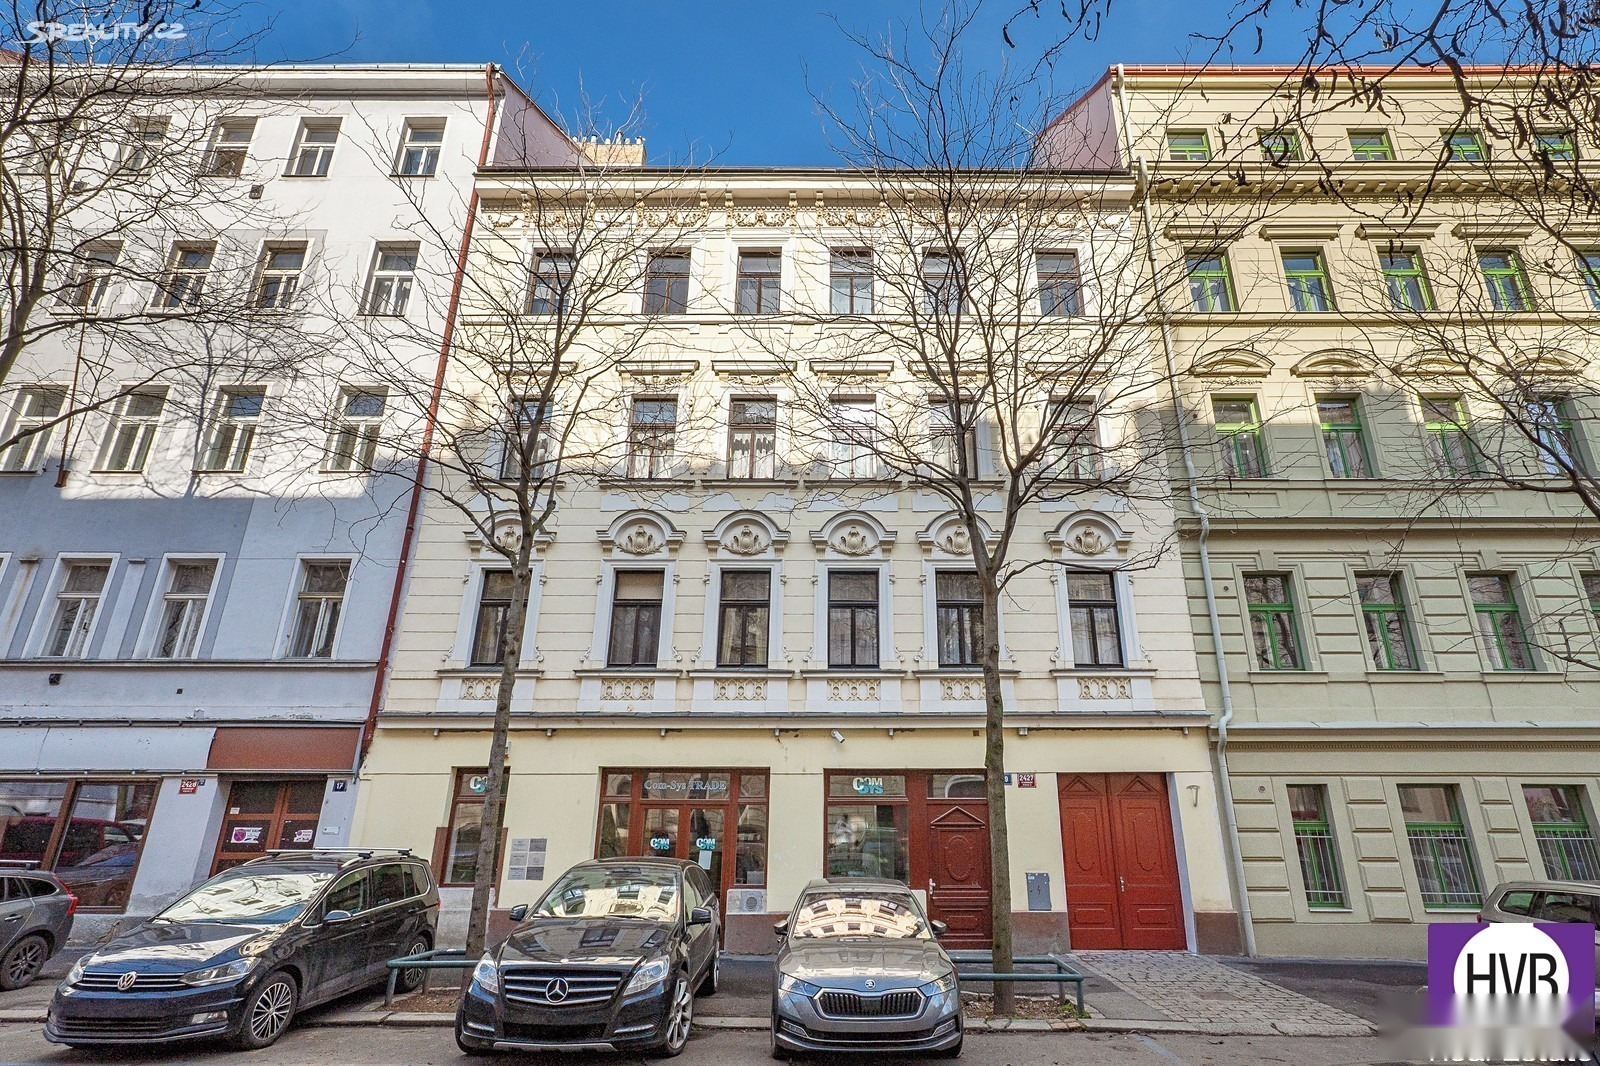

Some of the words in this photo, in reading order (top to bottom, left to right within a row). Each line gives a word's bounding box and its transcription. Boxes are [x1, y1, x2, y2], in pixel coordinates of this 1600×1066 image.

[336, 782, 344, 790] 17
[643, 780, 687, 791] Com-Sys
[689, 780, 727, 790] TRADE
